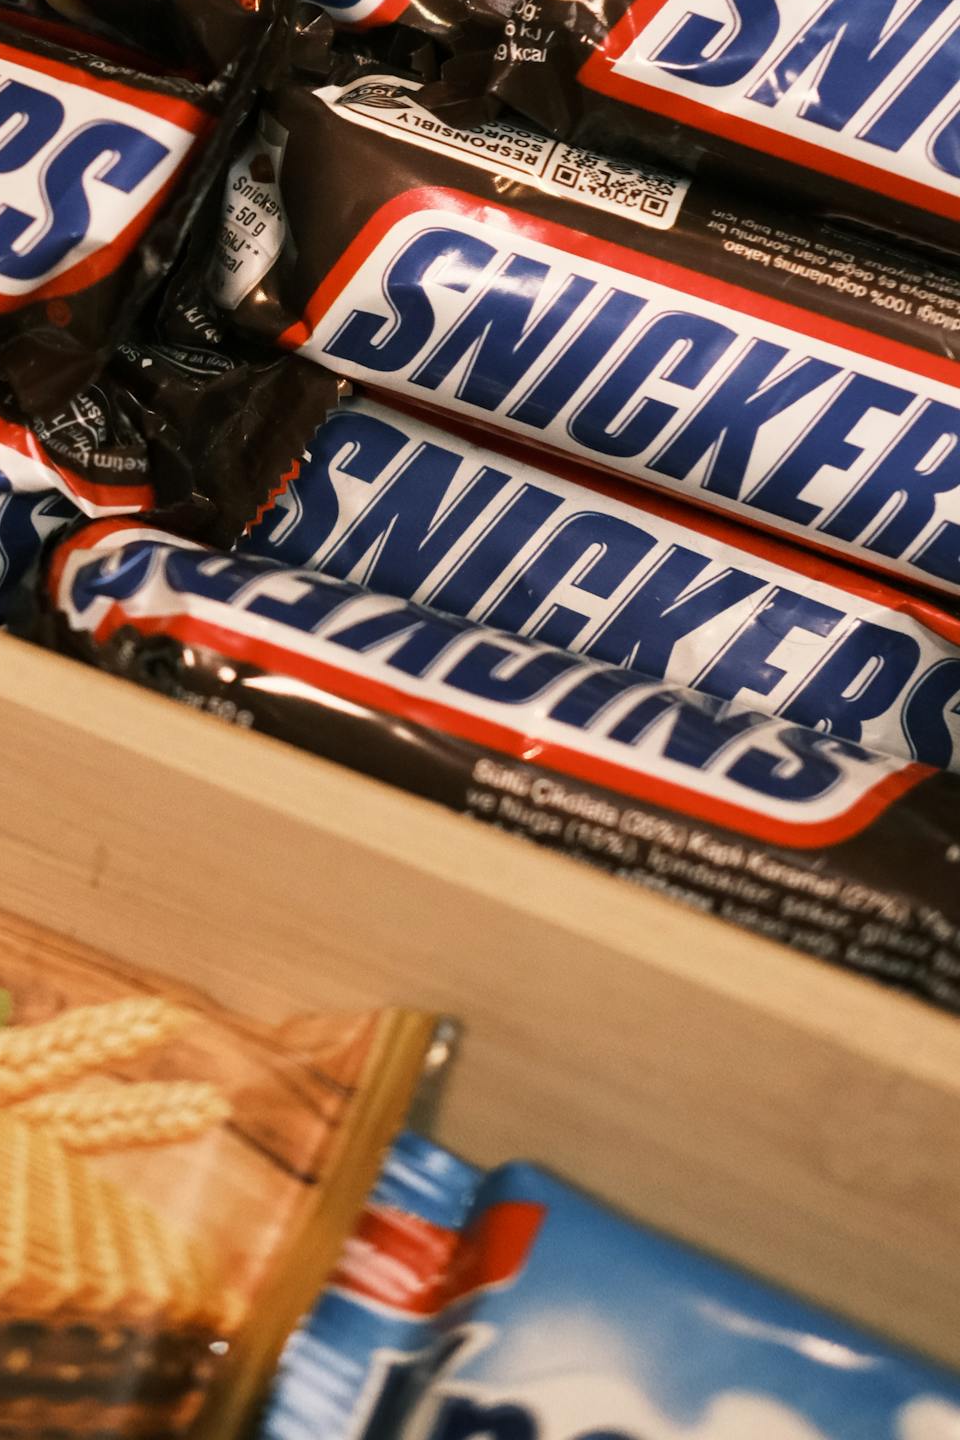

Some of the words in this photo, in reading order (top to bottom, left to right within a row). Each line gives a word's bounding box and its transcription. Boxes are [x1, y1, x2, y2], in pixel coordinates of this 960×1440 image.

[510, 42, 547, 62] kcal
[397, 110, 538, 166] RESPONSIBLY
[470, 124, 543, 152] SOURC
[235, 206, 255, 226] 50
[251, 222, 266, 237] g
[706, 219, 727, 233] bir
[729, 226, 790, 254] sorumlu
[771, 253, 869, 299] doğrulanmış
[867, 288, 914, 315] 100%
[321, 227, 960, 585] SNICKER
